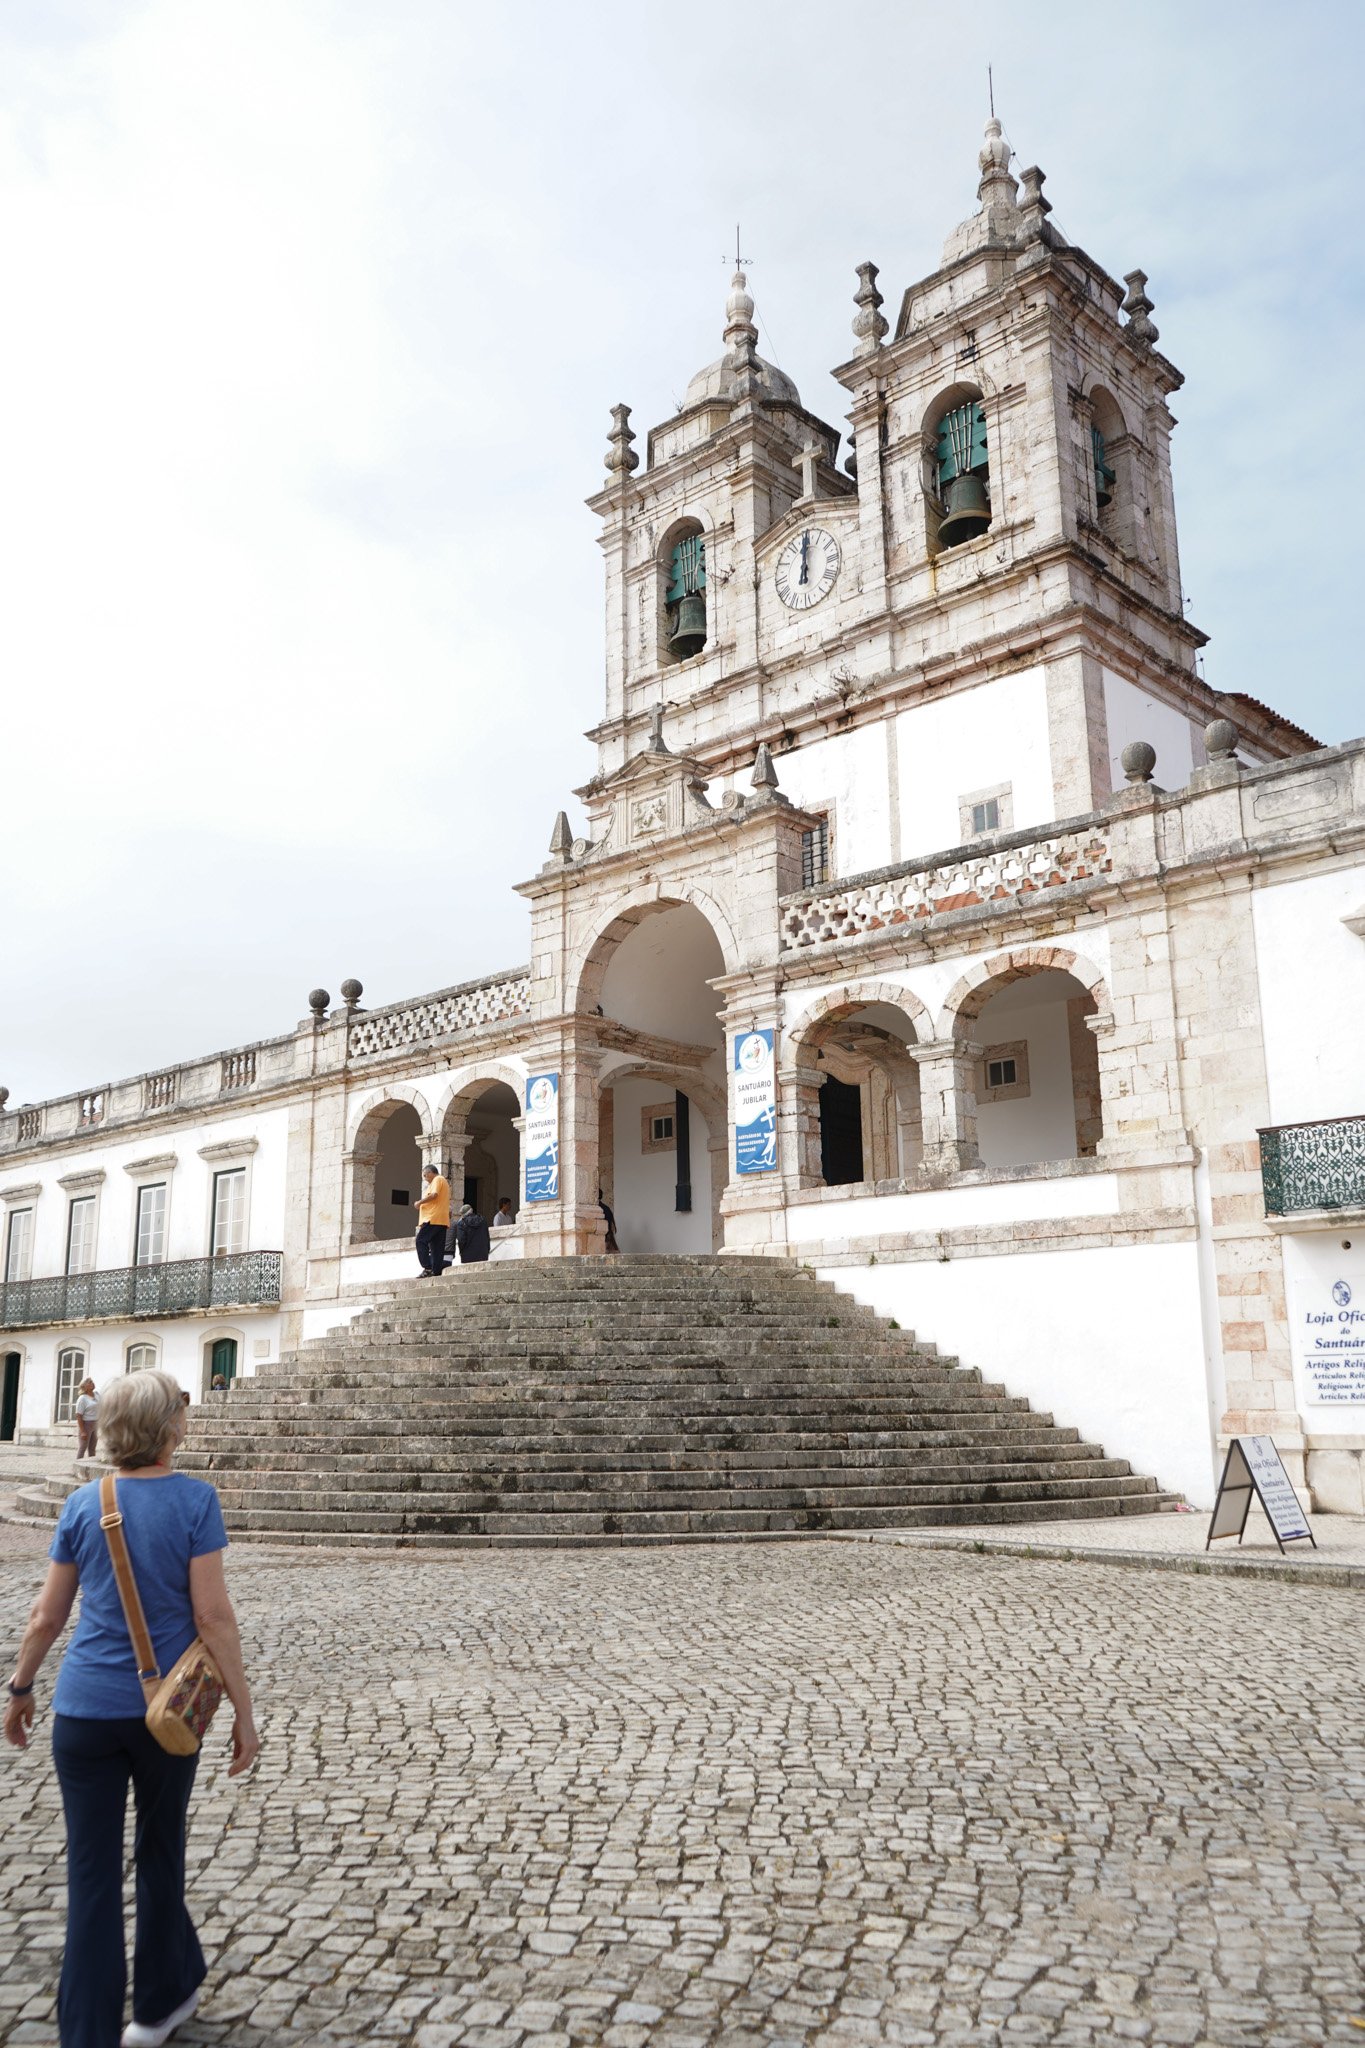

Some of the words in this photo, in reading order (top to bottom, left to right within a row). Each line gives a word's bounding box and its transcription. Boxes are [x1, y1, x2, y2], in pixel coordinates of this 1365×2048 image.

[738, 1080, 771, 1092] SANTUÁRIO
[742, 1094, 767, 1106] JUBILAR
[532, 1131, 552, 1141] JUBILAR
[1306, 1311, 1334, 1326] Loja
[1340, 1327, 1351, 1335] do
[1305, 1360, 1340, 1371] Artigos
[1318, 1382, 1353, 1391] Religious
